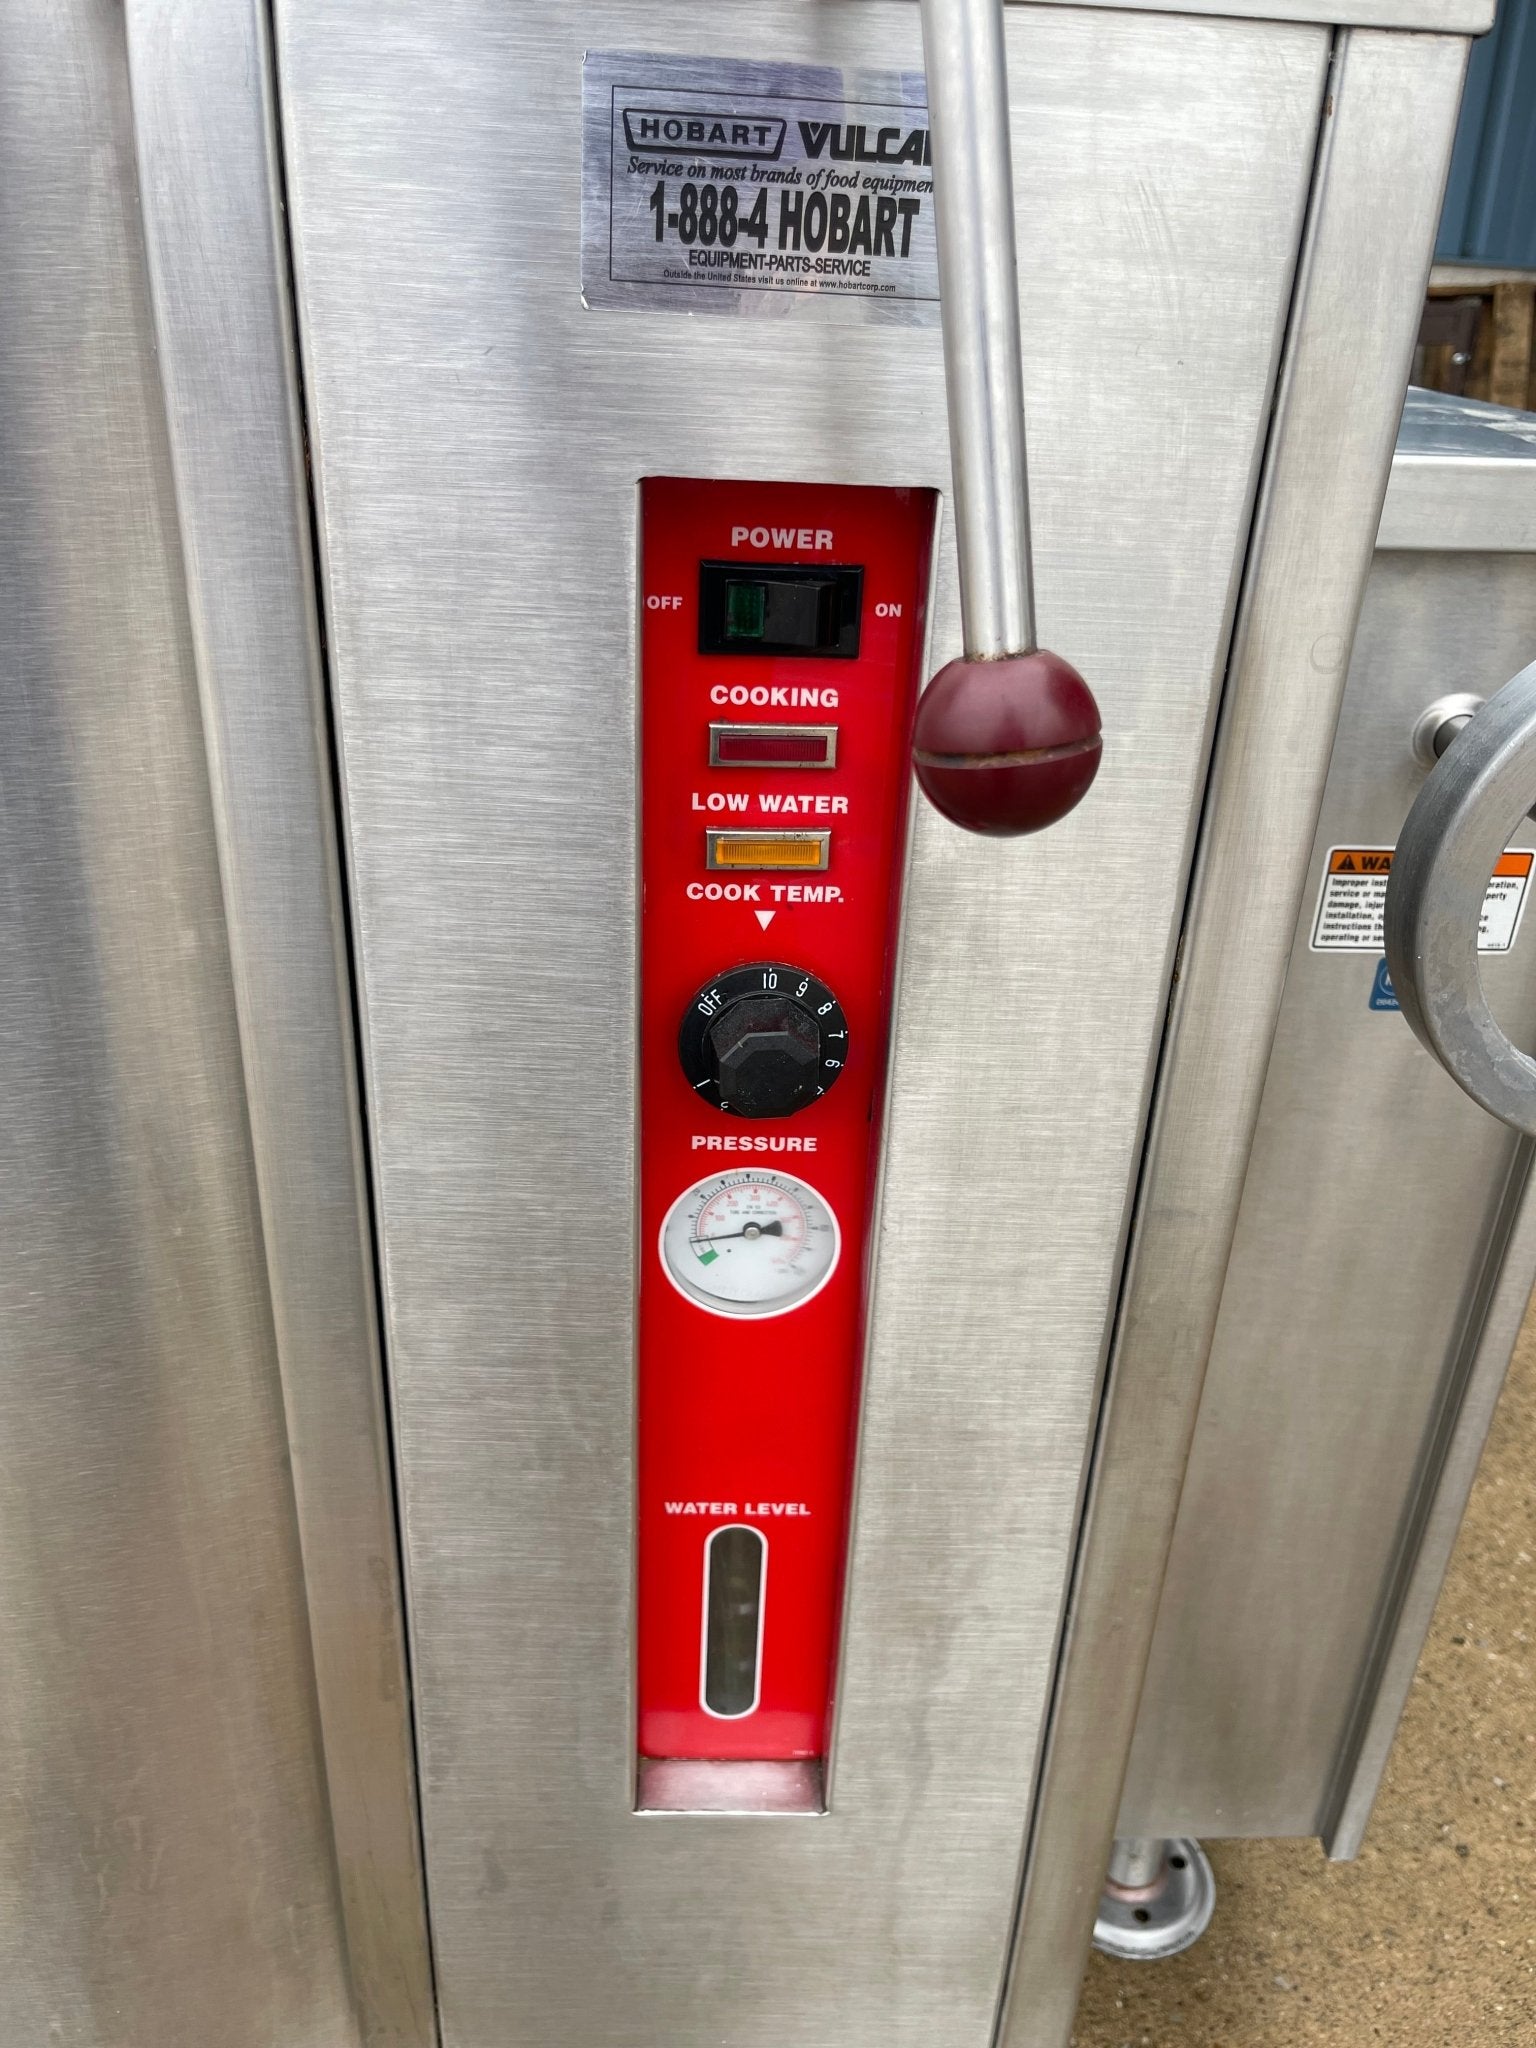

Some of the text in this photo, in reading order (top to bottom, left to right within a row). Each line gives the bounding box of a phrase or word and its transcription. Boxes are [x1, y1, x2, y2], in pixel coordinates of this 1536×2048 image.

[640, 118, 772, 147] HOBART
[627, 156, 934, 195] Service on most brands of food equipmen
[650, 181, 921, 258] 1-888-4 HOBART
[689, 250, 872, 277] EQUIPMENT-PARTS-SERVICE
[663, 269, 692, 280] Outside
[694, 271, 706, 280] the
[708, 272, 731, 282] United
[734, 273, 756, 283] States
[758, 275, 773, 285] visit
[786, 278, 808, 287] online
[810, 279, 817, 287] at
[819, 280, 896, 293] www.hobartcorp.com
[731, 526, 834, 550] POWER
[647, 596, 683, 610] OFF
[875, 603, 902, 617] ON
[710, 685, 839, 708] COOKING
[692, 793, 848, 814] LOW WATER
[1332, 878, 1368, 887] Improper
[686, 883, 844, 903] COOK TEMP.
[1365, 901, 1384, 909] injur
[1321, 934, 1359, 942] operating
[763, 973, 777, 989] 10
[796, 982, 808, 998] 9
[698, 989, 721, 1016] OFF
[817, 1002, 832, 1015] 8
[828, 1030, 844, 1039] 7
[691, 1135, 818, 1152] PRESSURE
[664, 1501, 811, 1516] WATER LEVEL
